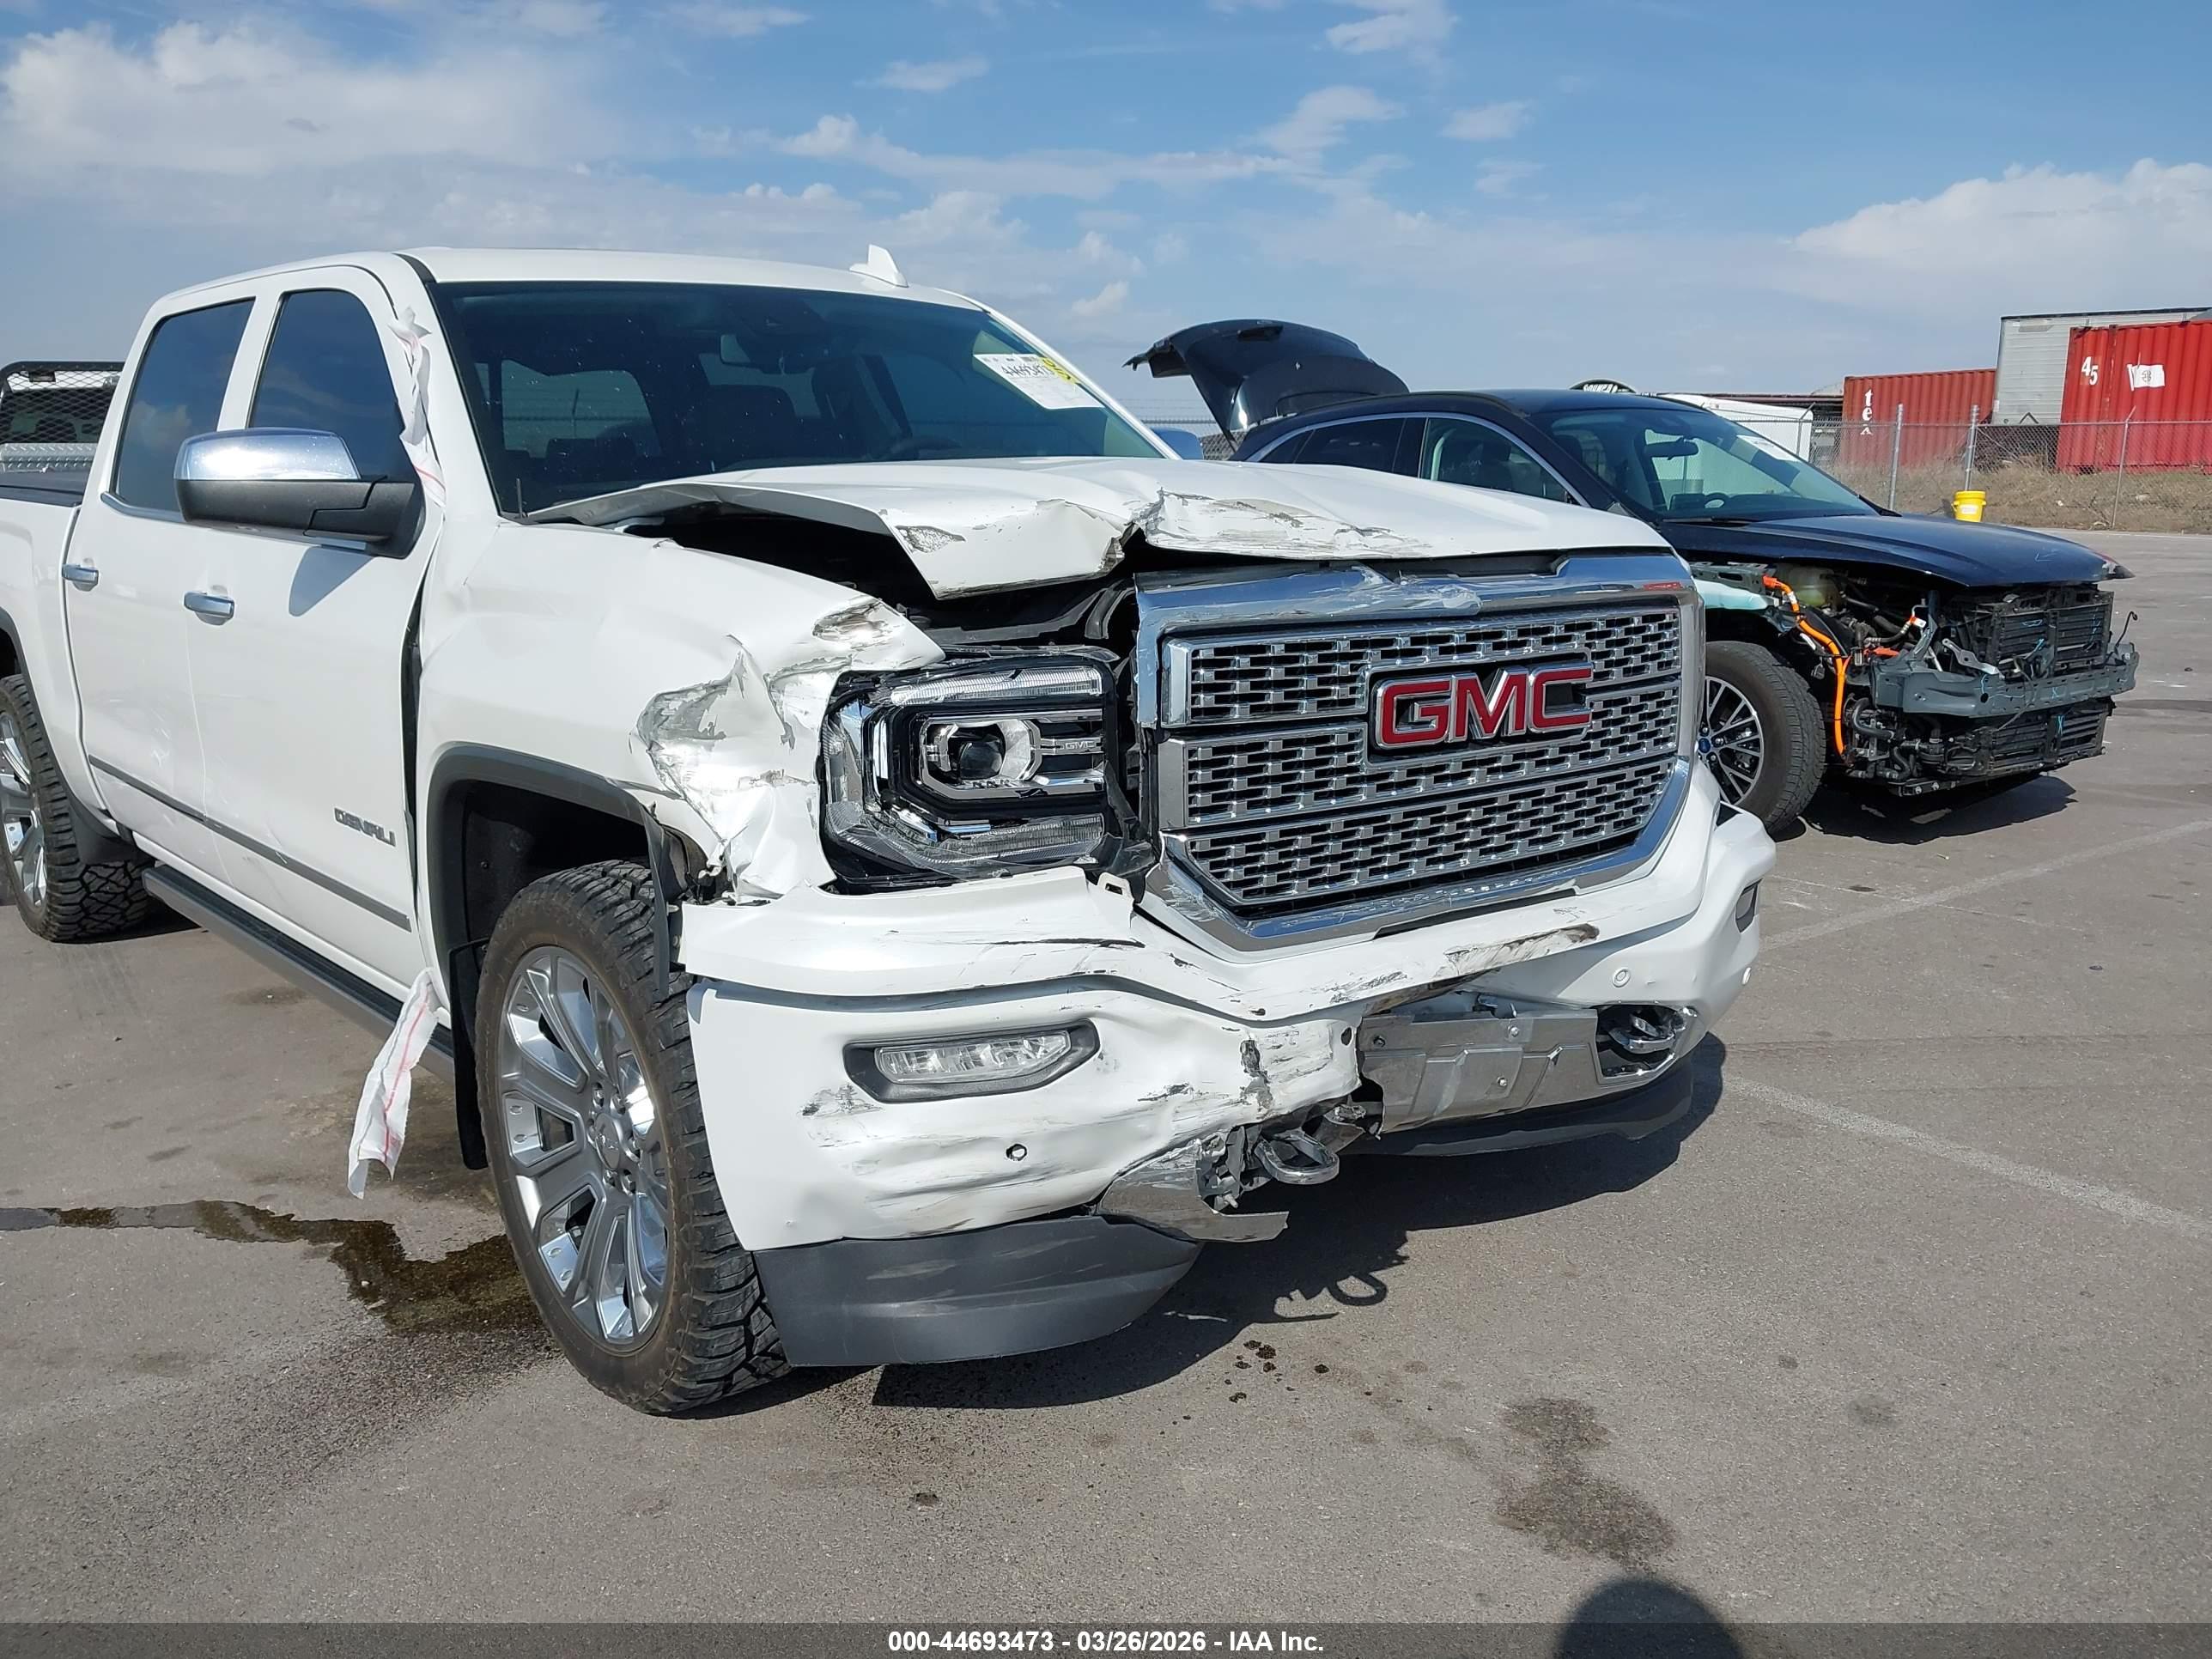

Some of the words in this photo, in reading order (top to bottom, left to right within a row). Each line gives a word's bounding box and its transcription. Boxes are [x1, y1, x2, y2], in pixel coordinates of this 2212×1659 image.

[2081, 356, 2099, 386] 45
[1374, 662, 1594, 750] GMC
[1065, 739, 1096, 750] GMC
